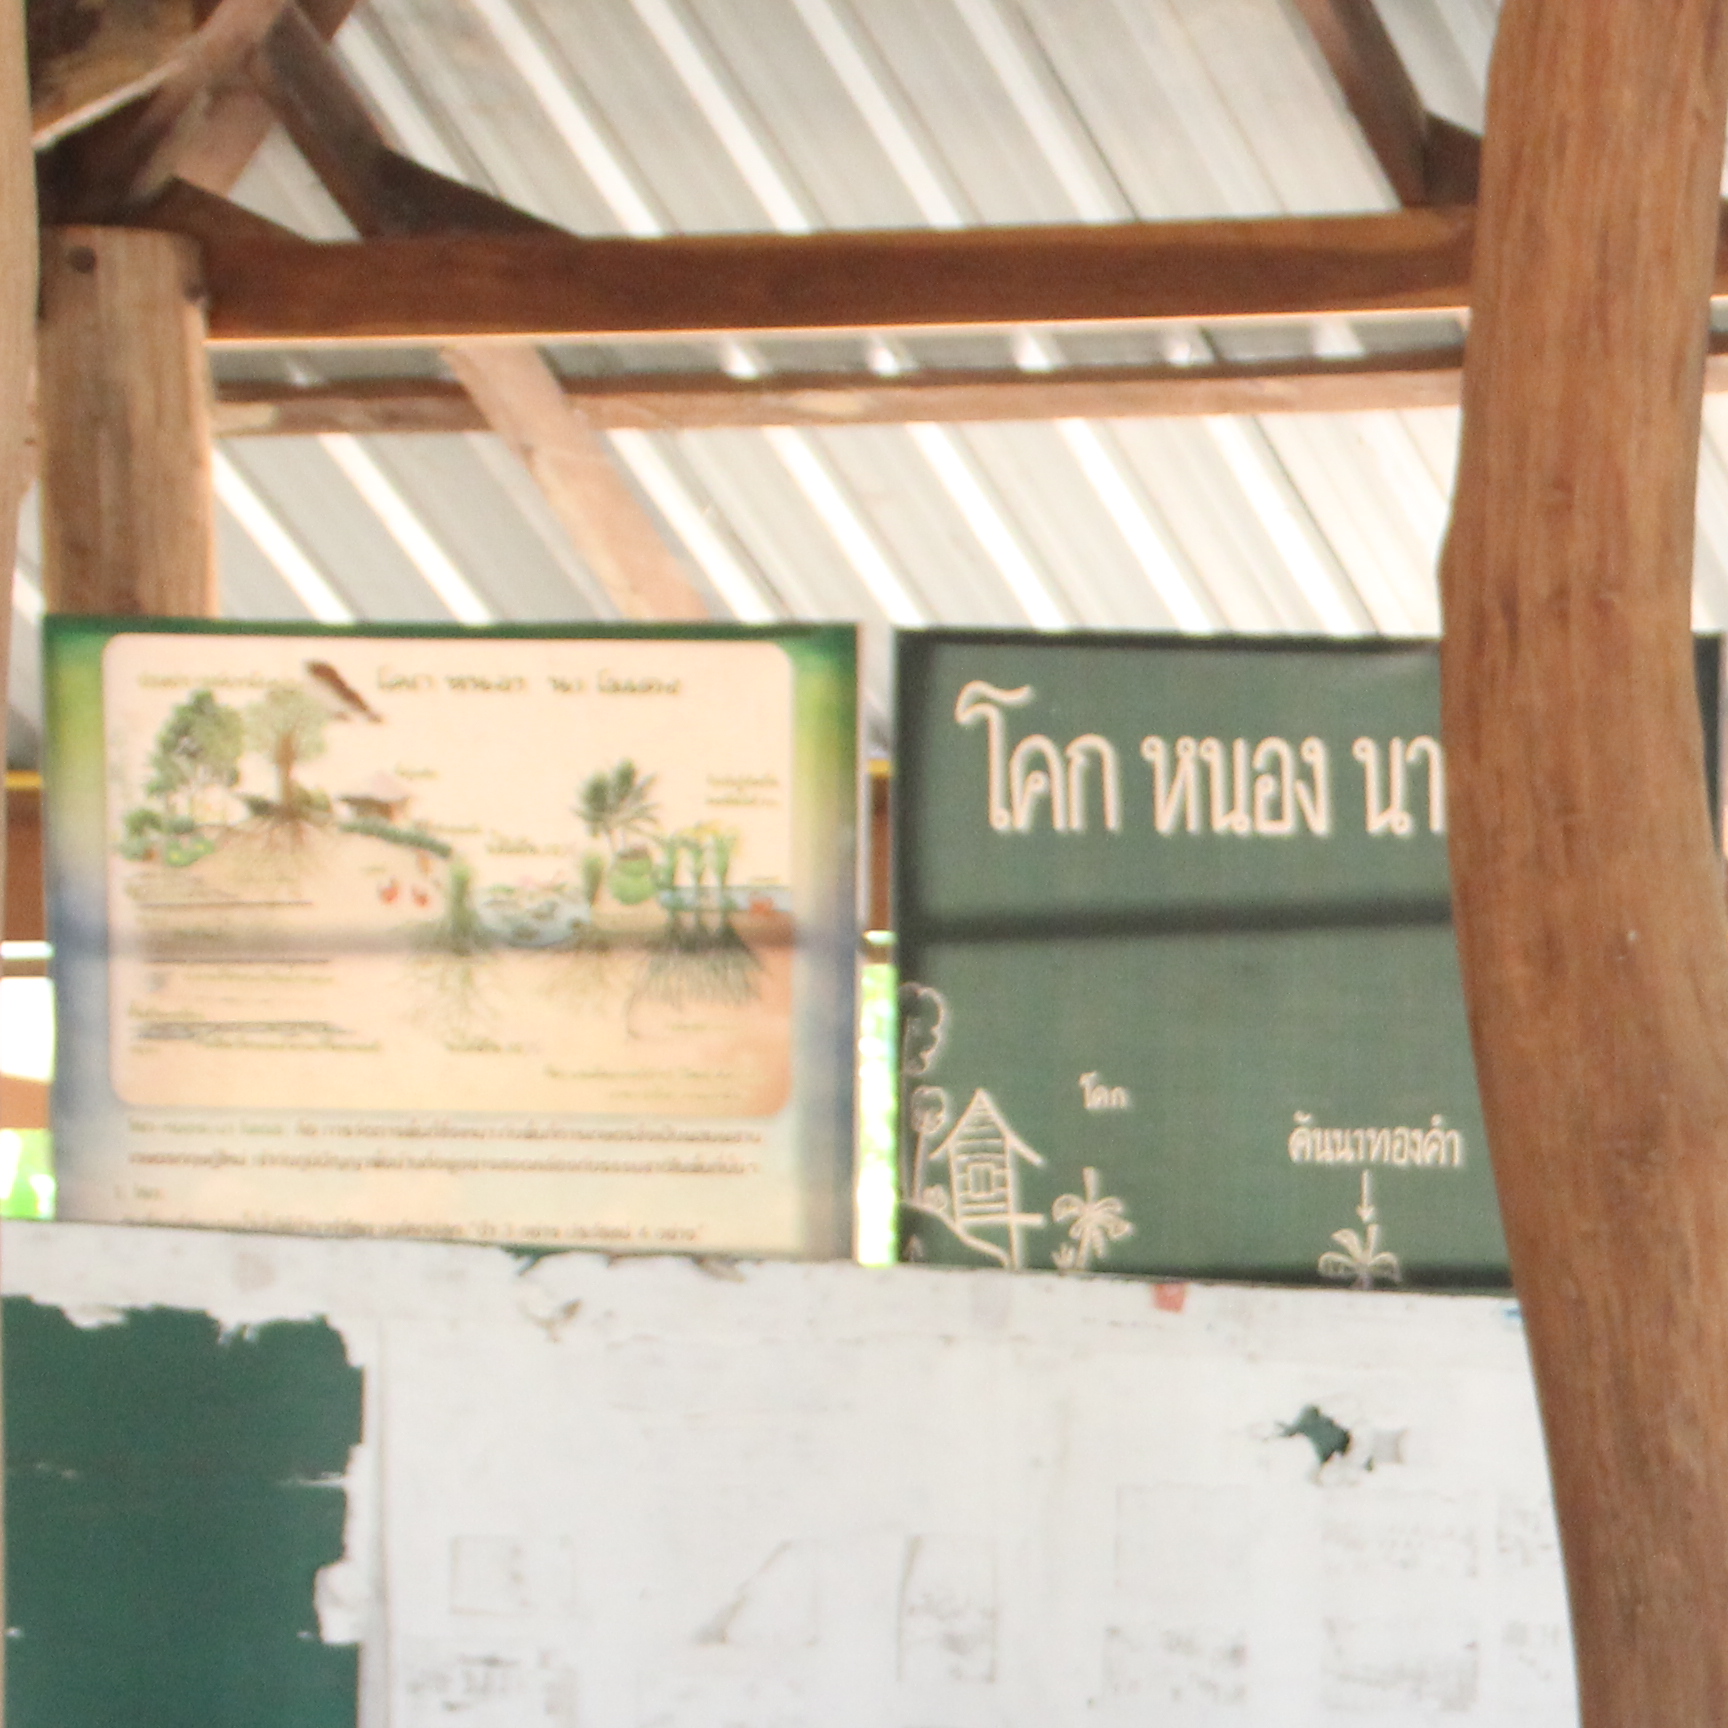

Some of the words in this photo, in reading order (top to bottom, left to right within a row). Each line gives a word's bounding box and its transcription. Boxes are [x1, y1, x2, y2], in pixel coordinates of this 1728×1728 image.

[953, 679, 1121, 833] โคก
[1140, 734, 1331, 837] หนอง
[1351, 734, 1446, 837] นา
